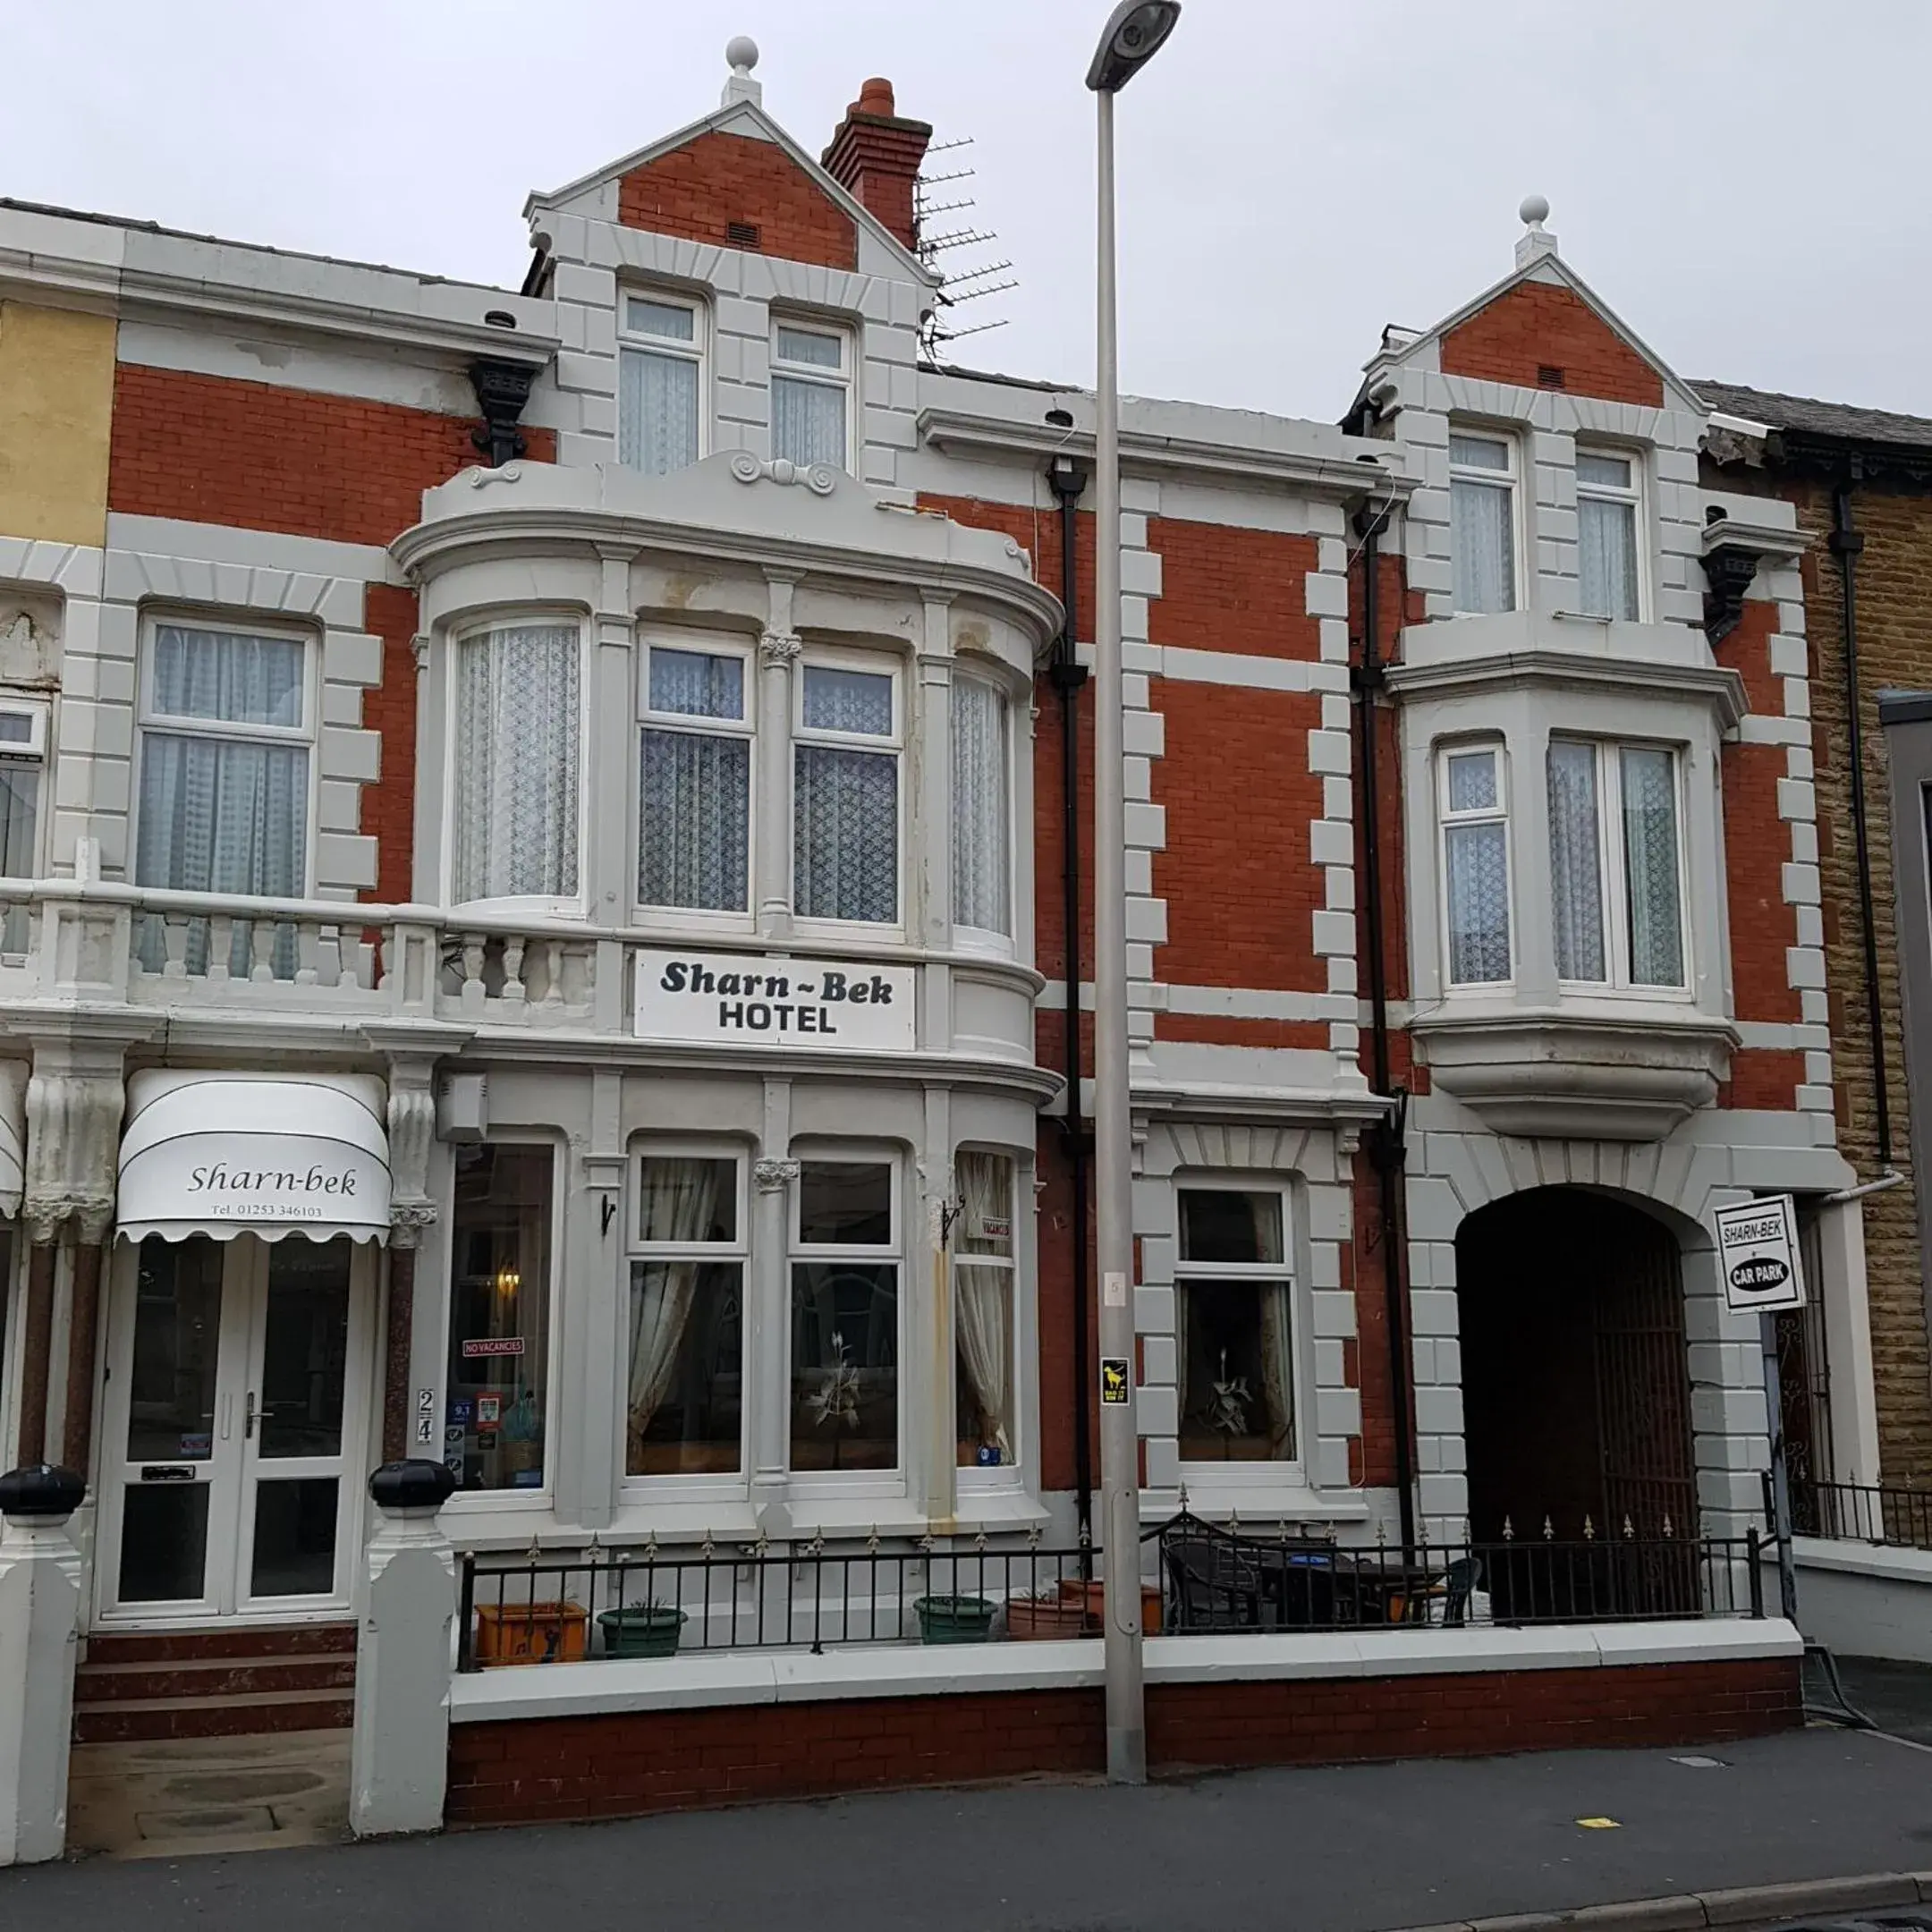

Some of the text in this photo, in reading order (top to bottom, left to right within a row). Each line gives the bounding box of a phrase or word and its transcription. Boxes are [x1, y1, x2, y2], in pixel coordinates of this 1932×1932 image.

[719, 1002, 837, 1034] HOTEL
[187, 1163, 357, 1196] Sharn-bek
[237, 1205, 275, 1216] 01253
[279, 1206, 322, 1216] 346103
[1724, 1220, 1782, 1242] SHARN-BEK
[1733, 1264, 1784, 1285] CAR PARK
[465, 1342, 521, 1353] NO VACANCIES
